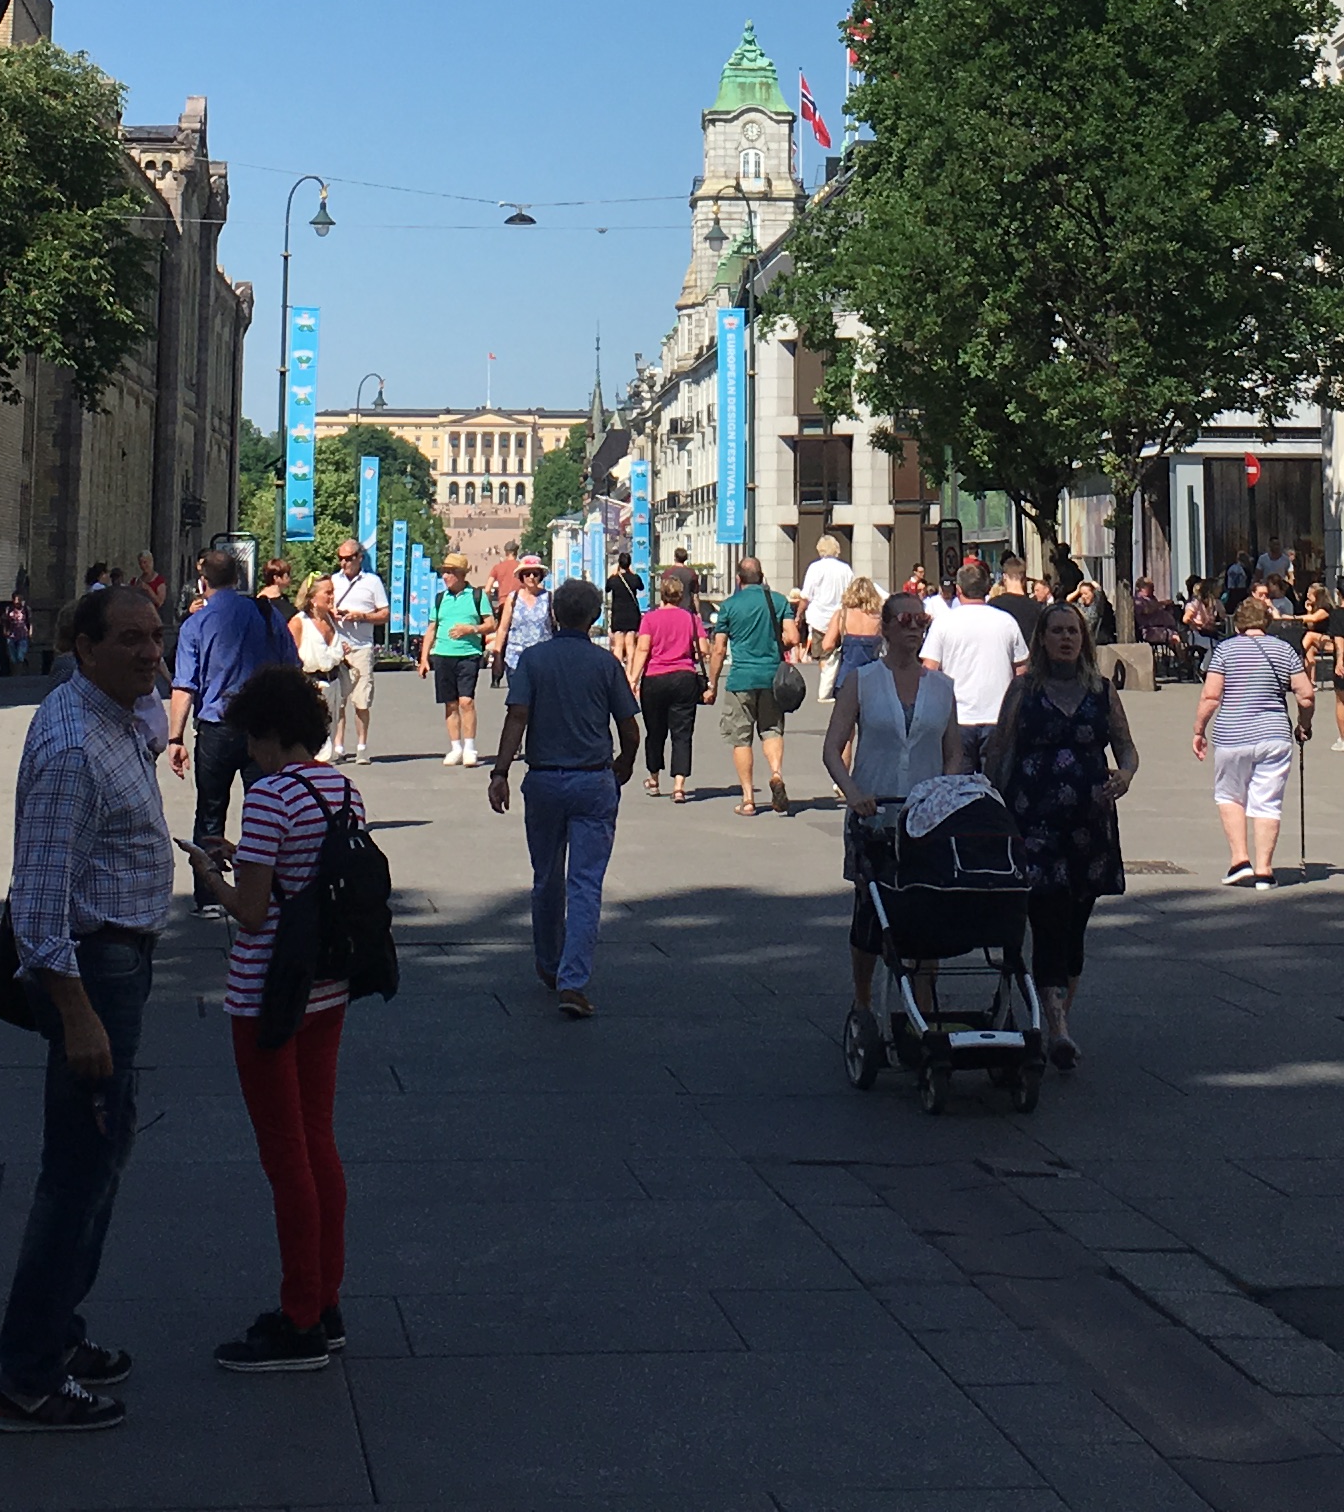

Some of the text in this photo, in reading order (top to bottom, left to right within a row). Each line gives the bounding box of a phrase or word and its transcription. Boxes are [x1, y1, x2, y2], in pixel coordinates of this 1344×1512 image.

[726, 333, 737, 527] EUROPEAN DESIGN FESTIVAL 2018
